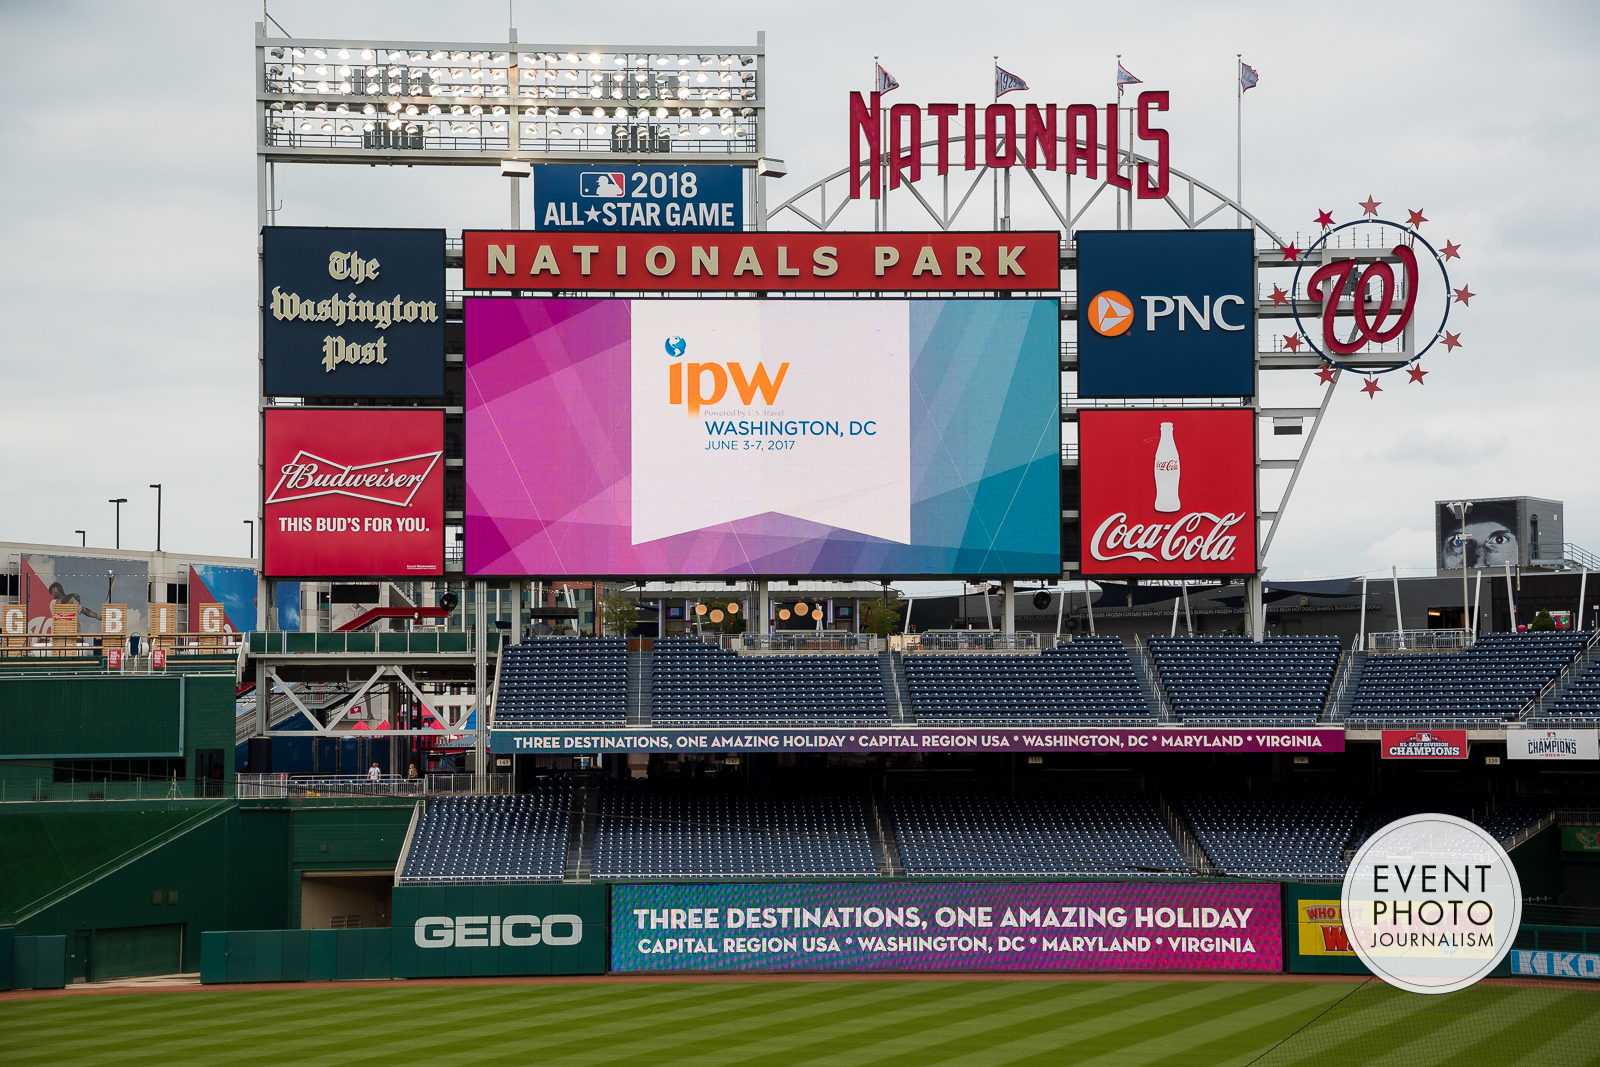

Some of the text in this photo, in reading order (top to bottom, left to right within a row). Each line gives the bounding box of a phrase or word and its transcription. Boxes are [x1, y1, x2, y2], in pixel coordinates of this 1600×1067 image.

[850, 90, 1169, 199] NATIONALS
[631, 171, 698, 198] 2018
[543, 202, 735, 227] ALL STAR GAME
[328, 250, 380, 285] The
[487, 244, 1026, 277] NATIONALS PARK
[270, 286, 438, 330] Washington
[1140, 294, 1245, 332] PNC
[321, 335, 387, 373] Post
[669, 361, 790, 419] ipw
[704, 409, 736, 417] Powered
[737, 409, 746, 419] by
[763, 409, 785, 417] Travel
[705, 420, 877, 438] WASHINGTON, DC
[705, 440, 796, 452] JUNE 3-7, 2017
[281, 463, 424, 490] Budweiser
[279, 517, 430, 532] THIS BUD'S FOR YOU.
[1090, 512, 1246, 562] Coca-Cola
[514, 735, 1322, 750] THREE DESTINATIONS, ONE AMAZING HOLIDAY CAPITAL REGION USA WASHINGTON, DC MARYLAND VIRGINIA
[1389, 746, 1460, 756] CHAMPIONS
[1528, 740, 1577, 754] CHAMPIONS
[633, 907, 1253, 931] THREE DESTINATIONS, ONE AMAZING HOLIDAY
[1306, 907, 1336, 920] WHO
[414, 914, 583, 948] GEICO
[638, 936, 1257, 954] CAPITAL REGION USA WASHINGTON, DC MARYLAND VIRGINIA
